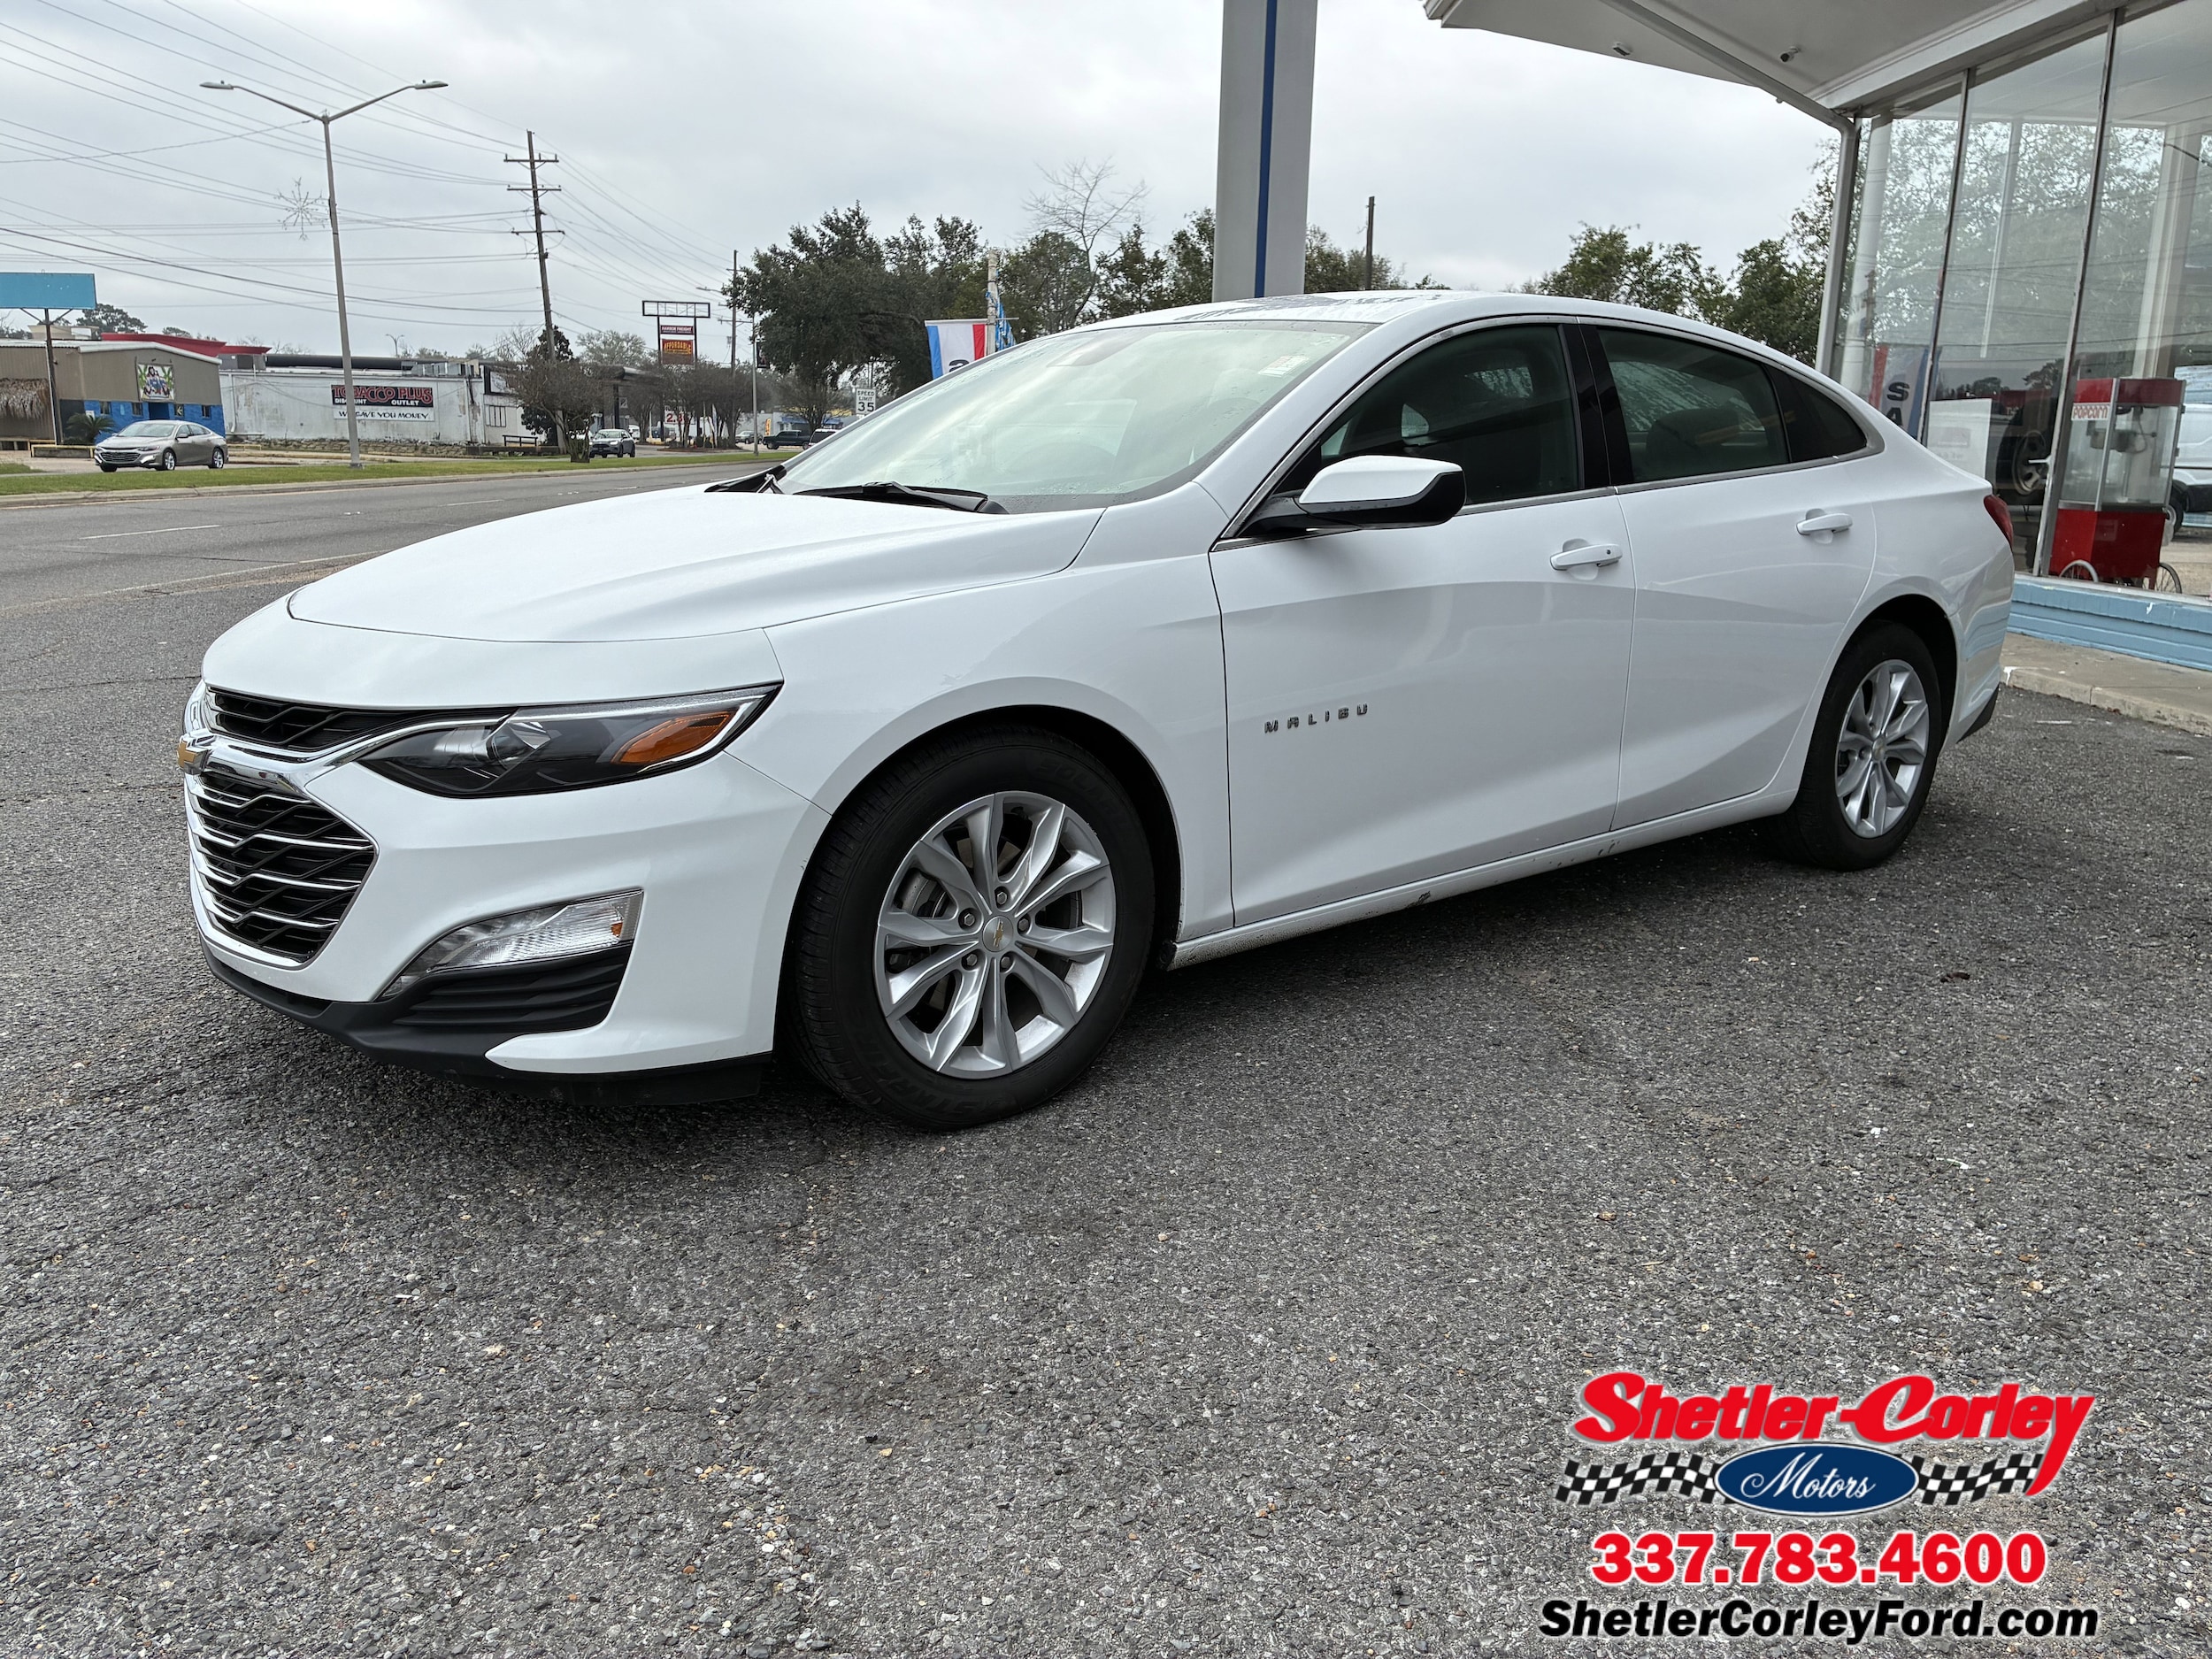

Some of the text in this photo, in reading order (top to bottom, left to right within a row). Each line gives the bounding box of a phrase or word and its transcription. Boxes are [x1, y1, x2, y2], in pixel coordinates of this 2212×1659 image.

[664, 342, 691, 351] AFFORDABLE
[398, 388, 433, 404] PLUS
[858, 402, 874, 411] 35
[2073, 405, 2108, 419] POPCORN
[1263, 703, 1368, 733] MALIBU
